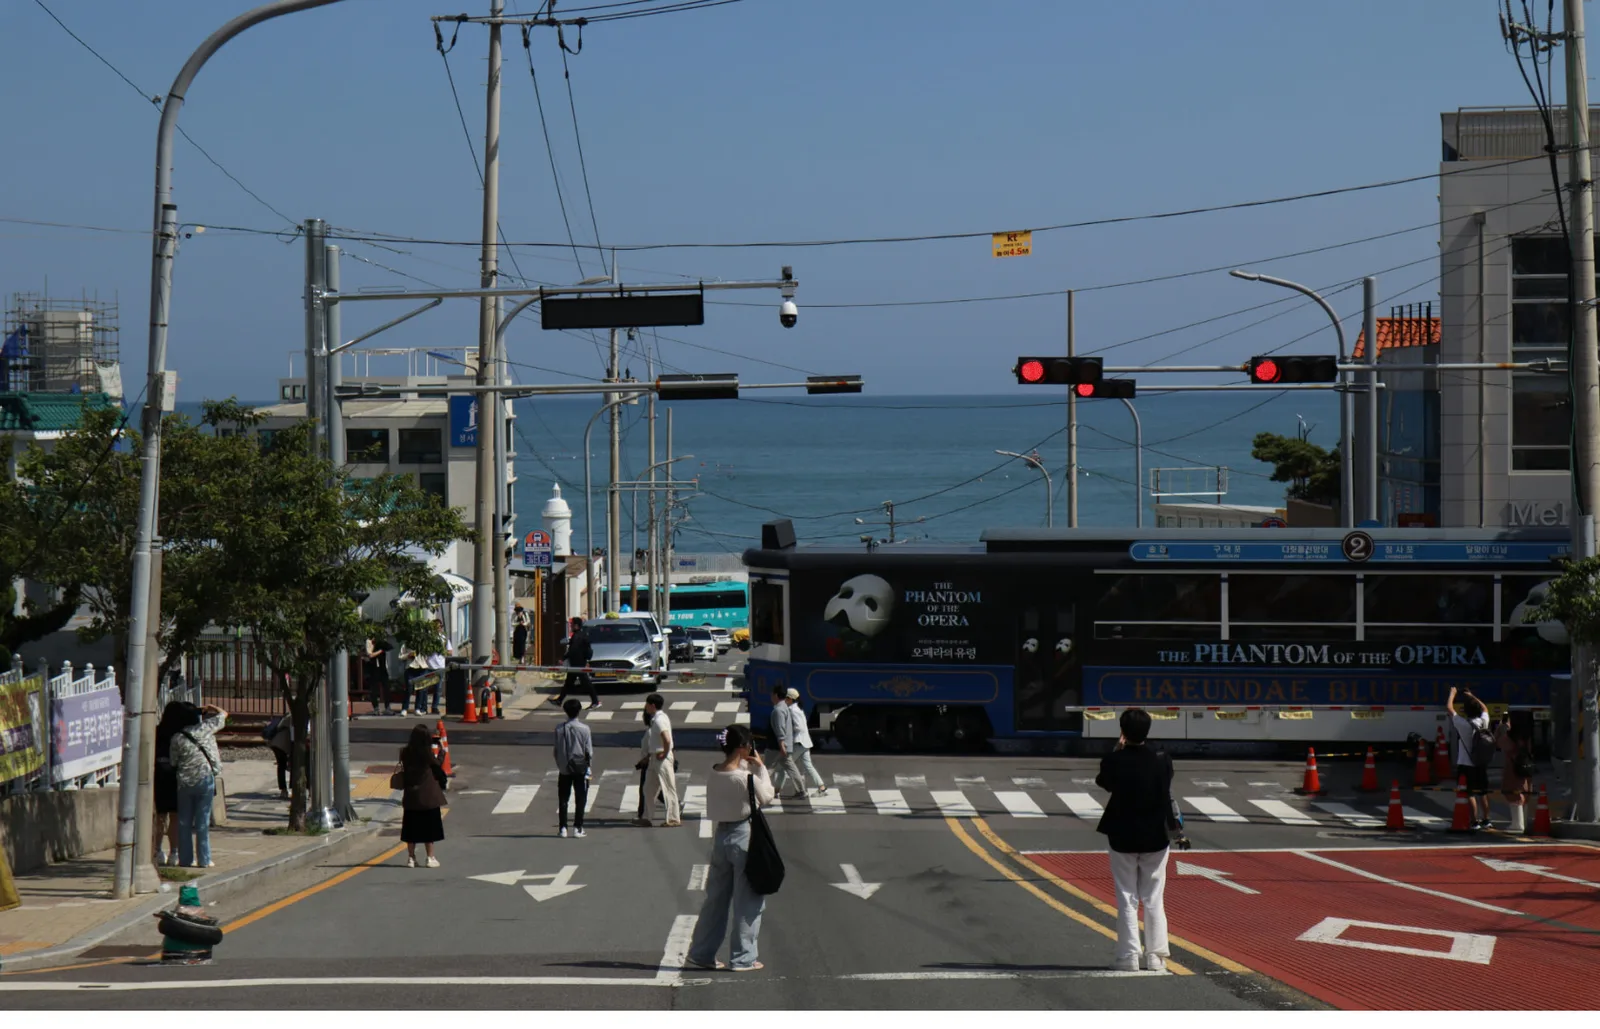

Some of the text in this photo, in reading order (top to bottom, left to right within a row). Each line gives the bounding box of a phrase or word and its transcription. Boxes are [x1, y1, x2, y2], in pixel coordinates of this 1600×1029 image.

[1350, 536, 1366, 557] 2
[933, 582, 953, 590] THE
[905, 590, 982, 603] PHANTOM
[927, 604, 960, 613] OF THE
[918, 614, 969, 627] OPERA
[911, 647, 976, 660] 오페라의 유령
[1157, 644, 1487, 666] THE PHANTOM OF THE OPERA
[1134, 678, 1310, 702] HAEUNDAE
